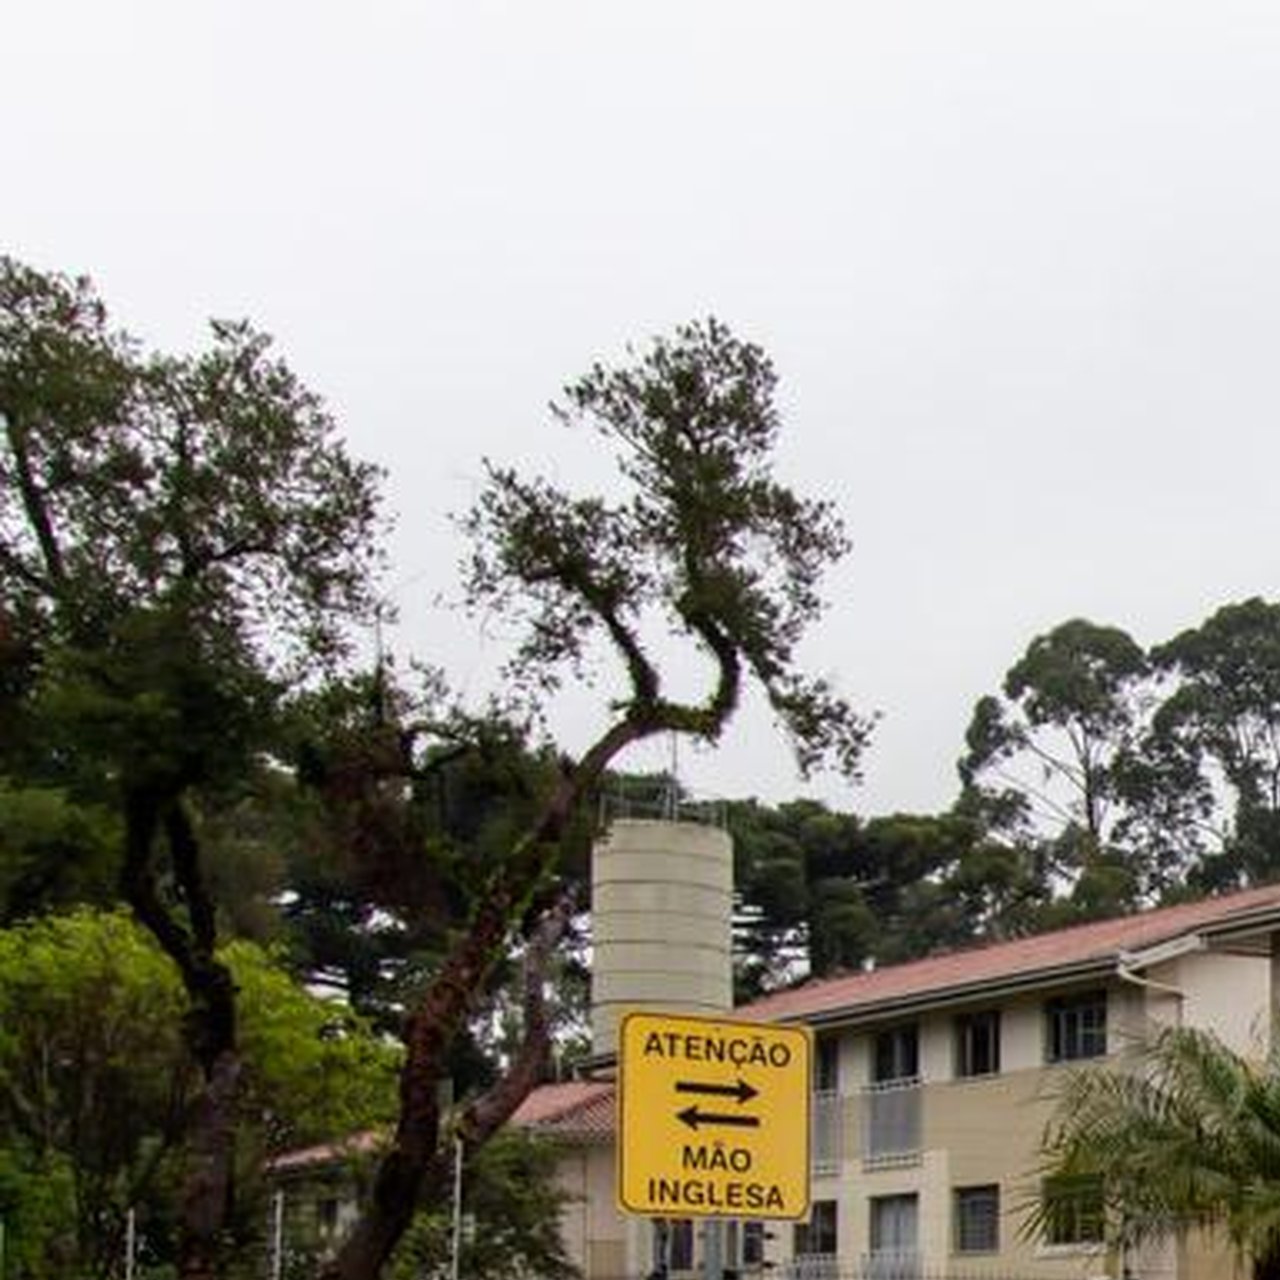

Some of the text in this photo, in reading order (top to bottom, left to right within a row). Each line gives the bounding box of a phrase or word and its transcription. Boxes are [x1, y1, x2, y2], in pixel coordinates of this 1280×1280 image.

[643, 1032, 791, 1070] ATENÇÃO
[682, 1140, 752, 1173] MÃO
[648, 1178, 785, 1210] INGLESA
